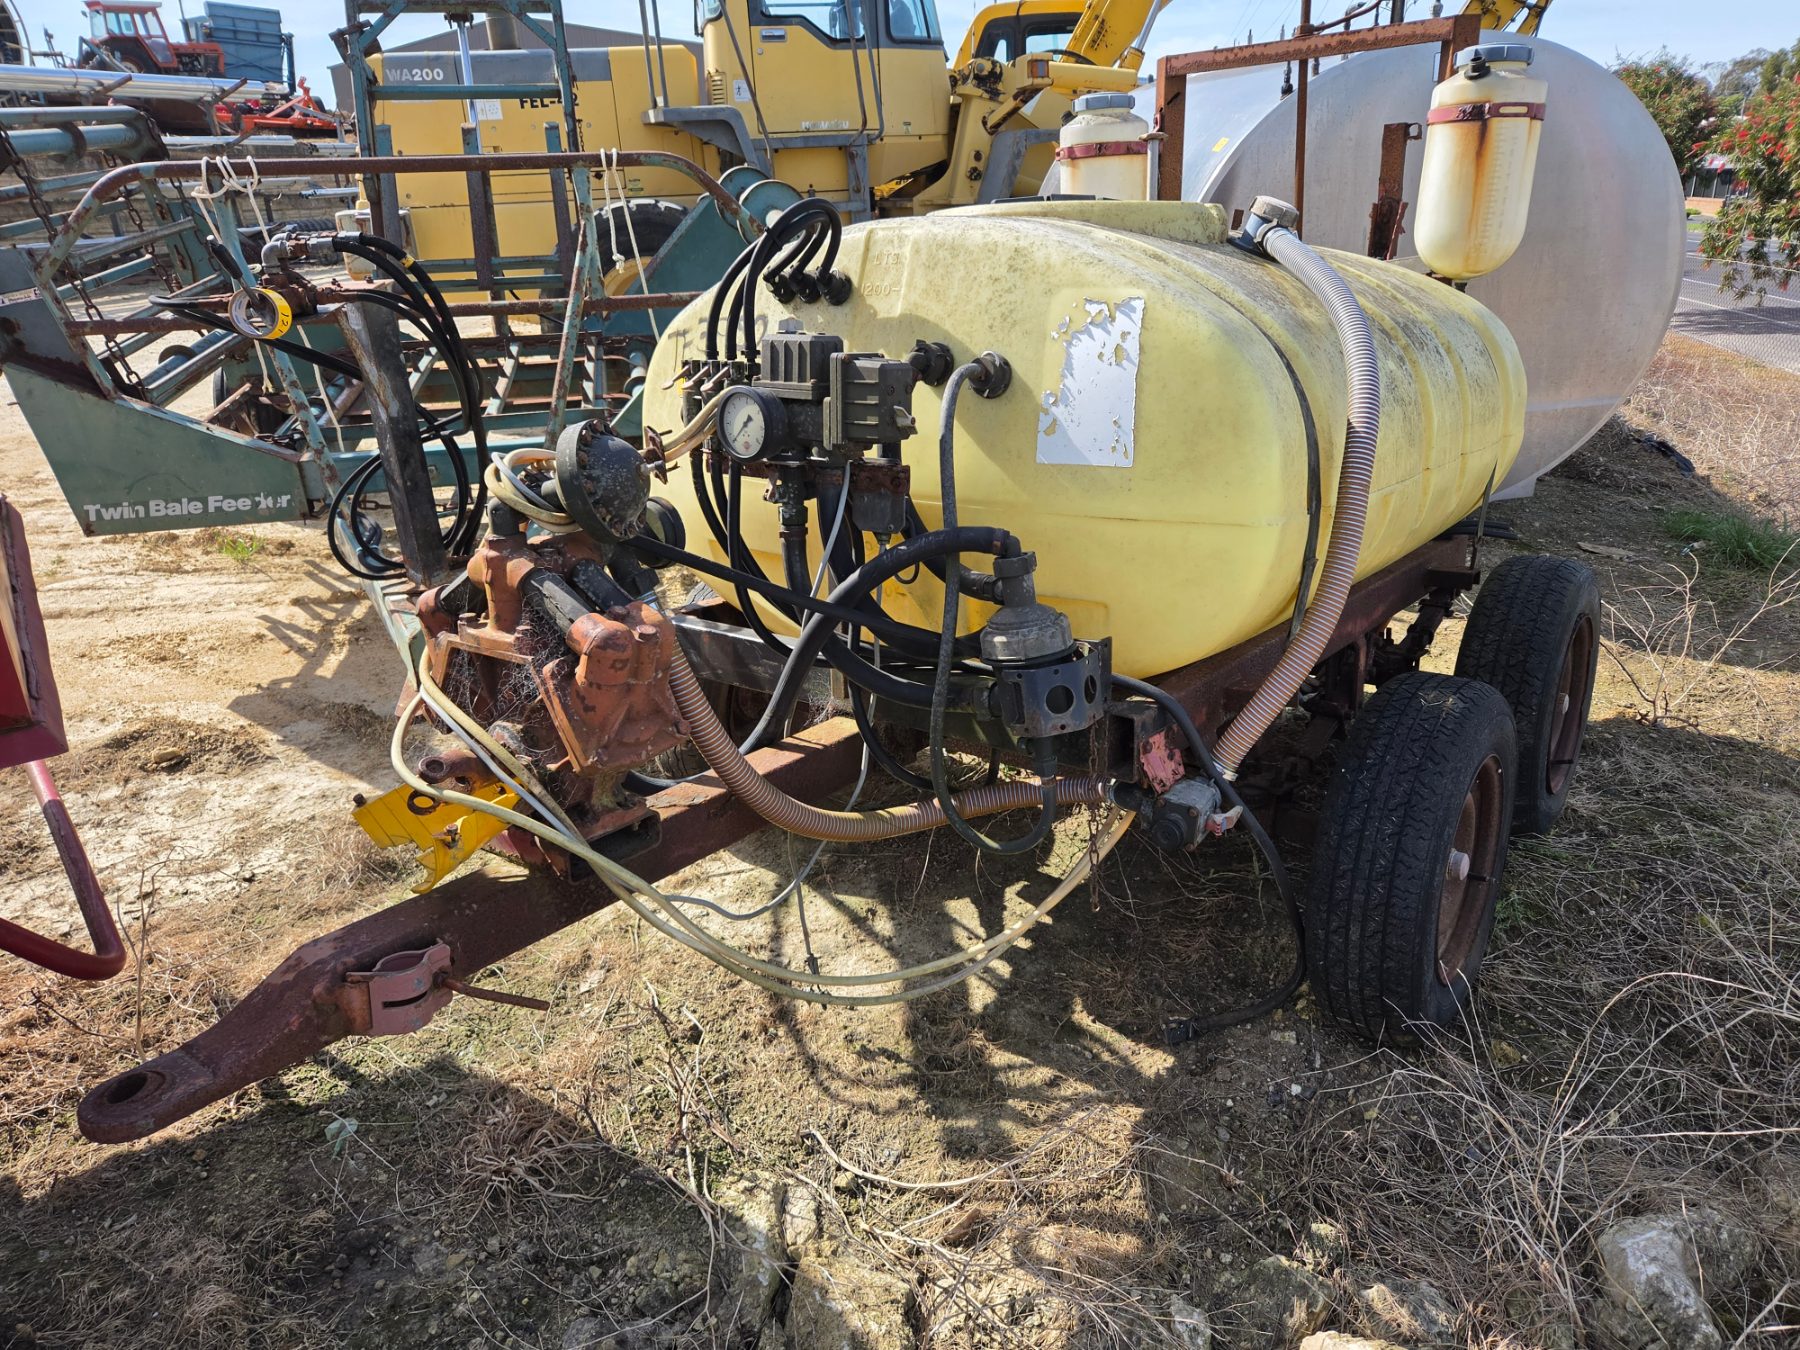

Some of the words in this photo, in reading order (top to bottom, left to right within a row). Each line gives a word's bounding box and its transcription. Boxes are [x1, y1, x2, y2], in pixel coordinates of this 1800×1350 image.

[386, 68, 444, 81] WA200
[83, 501, 145, 522] Twin
[150, 497, 203, 517] Bale
